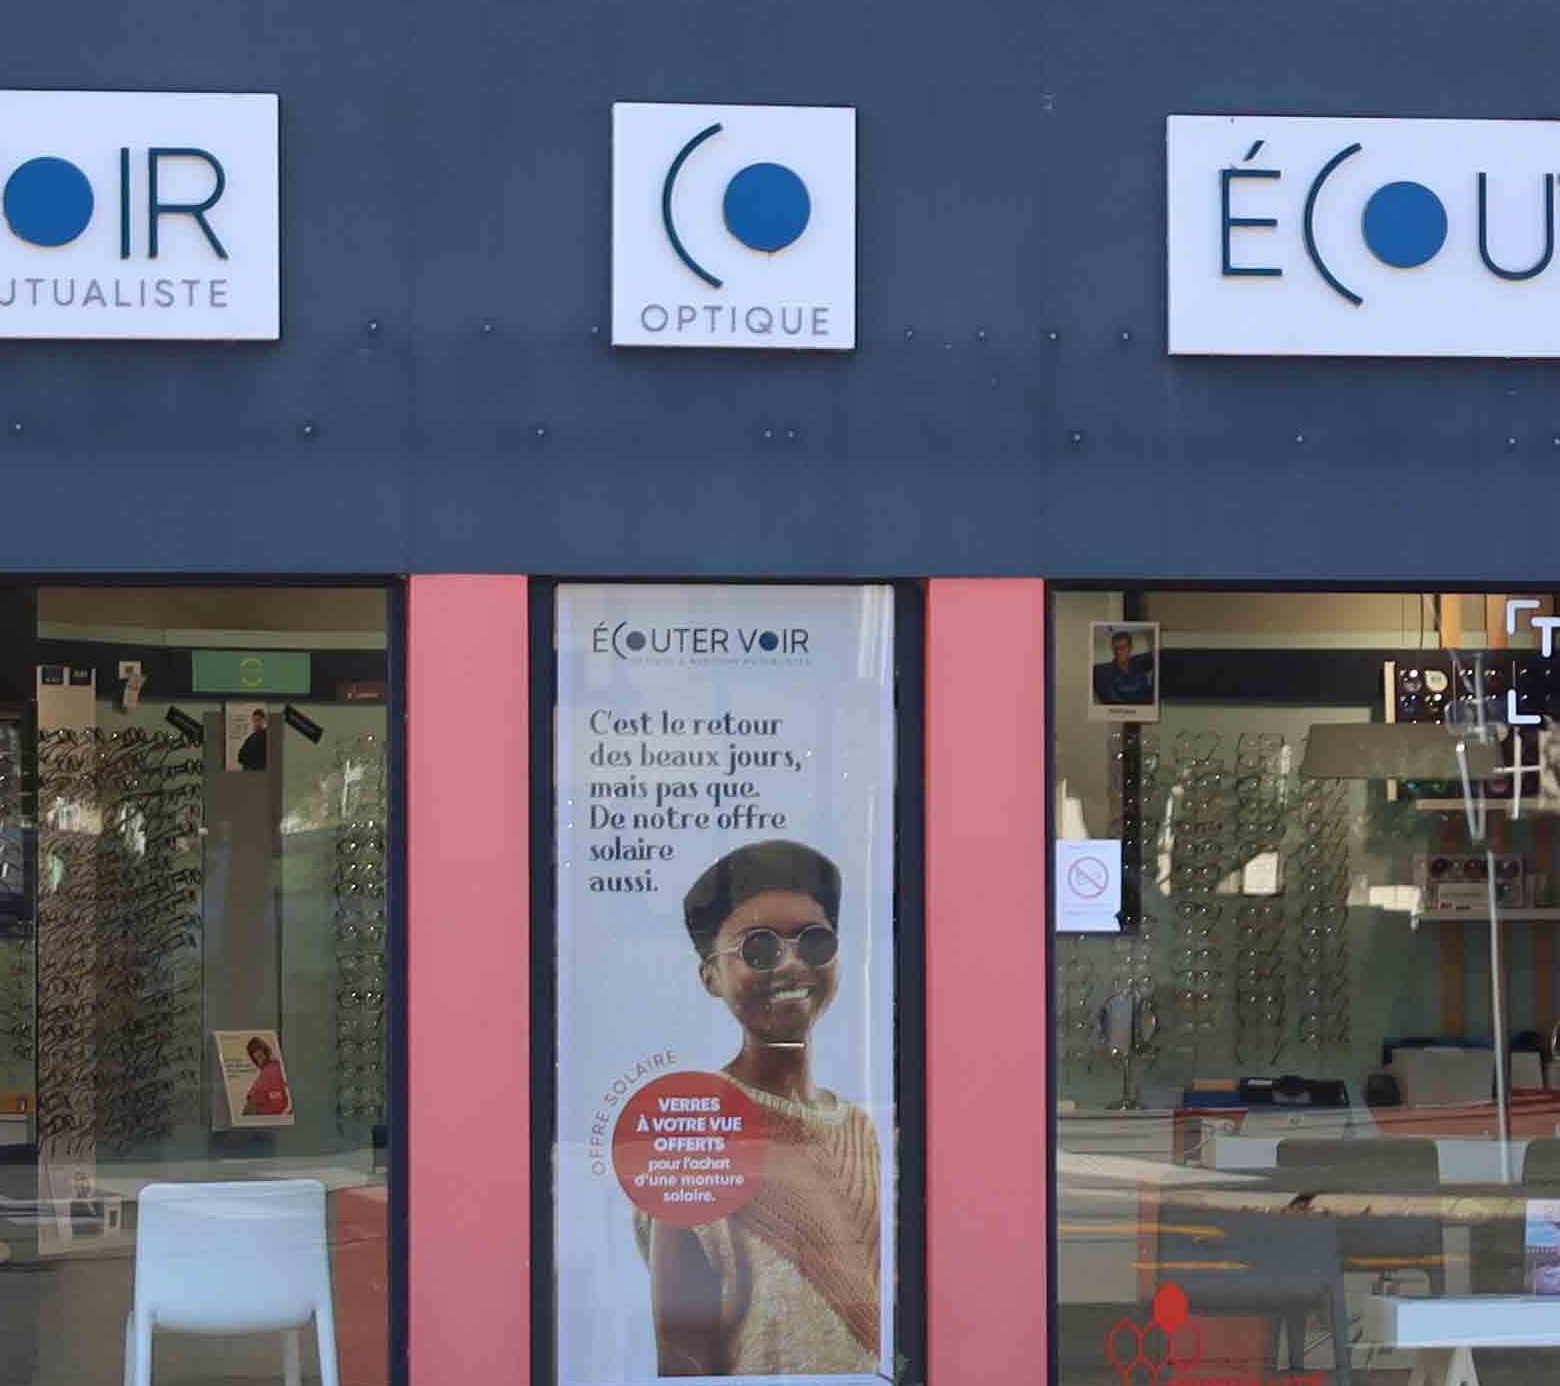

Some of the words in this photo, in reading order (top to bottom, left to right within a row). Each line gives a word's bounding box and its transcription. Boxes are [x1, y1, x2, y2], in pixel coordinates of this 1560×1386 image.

[640, 304, 830, 335] OPTIQUE
[737, 628, 810, 654] VOIR
[590, 709, 653, 735] C'est
[662, 710, 686, 735] le
[693, 711, 784, 735] retour
[589, 741, 633, 767] des
[641, 741, 721, 767] beaux
[724, 743, 802, 776] jours,
[590, 774, 648, 798] mais
[656, 781, 698, 807] pas
[706, 781, 761, 807] que.
[590, 804, 625, 830] De
[633, 806, 711, 830] notre
[717, 803, 787, 830] offre
[590, 836, 674, 861] solaire
[589, 869, 659, 893] aussi.
[589, 1110, 610, 1177] OFFRE
[603, 1049, 680, 1108] SOLAIRE
[657, 1097, 721, 1112] VERRES
[635, 1114, 649, 1132] À
[652, 1116, 706, 1132] VOTRE
[709, 1116, 743, 1132] VUE
[653, 1136, 727, 1152] OFFERTS
[648, 1158, 681, 1173] pour
[683, 1156, 731, 1170] l'achat
[634, 1173, 678, 1186] d'une
[680, 1175, 745, 1186] monture
[663, 1189, 717, 1202] solaire.
